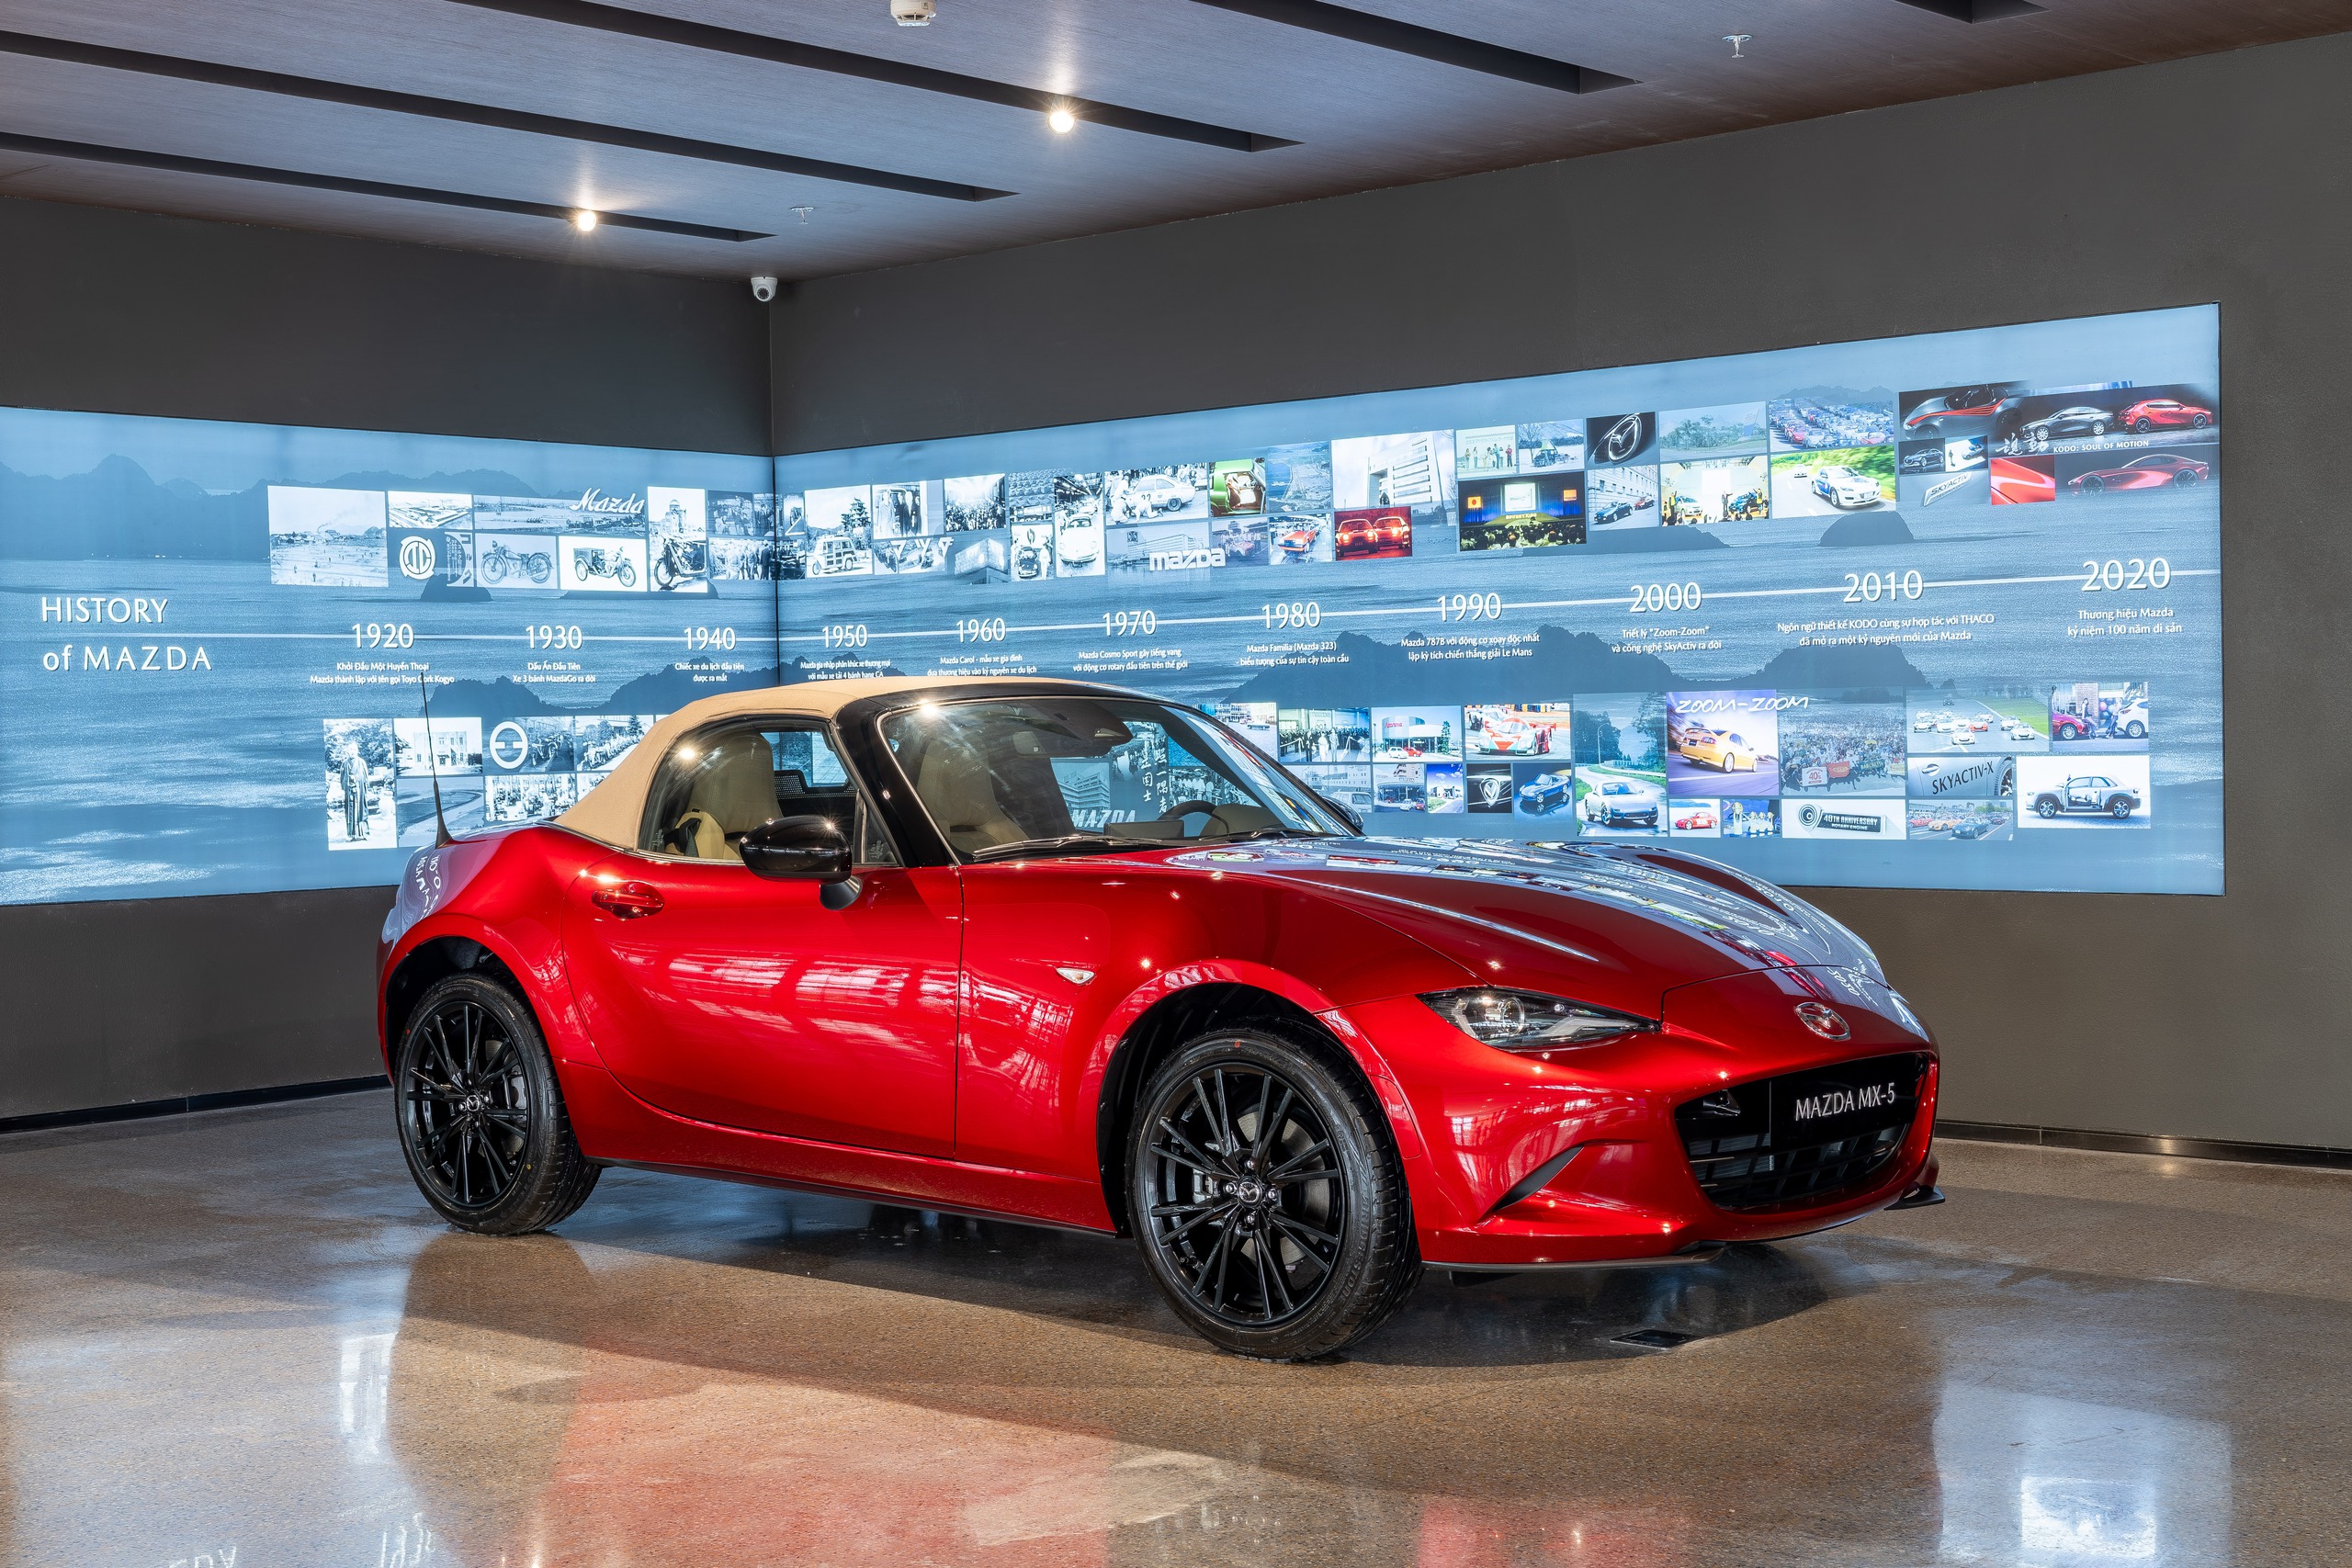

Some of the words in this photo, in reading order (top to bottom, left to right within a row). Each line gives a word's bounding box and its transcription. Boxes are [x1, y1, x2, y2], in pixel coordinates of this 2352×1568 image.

[2053, 445, 2079, 453] KODO:
[1931, 473, 1969, 496] SKYACTIV
[570, 487, 645, 514] Mazda
[890, 536, 954, 563] マツダ
[1148, 547, 1226, 571] mazda
[1843, 570, 1924, 602] 2010
[2081, 558, 2171, 592] 2020
[1437, 592, 1501, 621] 1990
[1630, 582, 1702, 613] 2000
[41, 597, 169, 624] HISTORY
[1261, 602, 1321, 628] 1980
[2078, 610, 2114, 623] Thương
[2116, 608, 2137, 620] hiệu
[2140, 606, 2174, 617] Mazda
[956, 617, 1006, 643] 1960
[1102, 610, 1156, 636] 1970
[1623, 627, 1638, 638] Triết
[1641, 628, 1647, 639] lý
[1649, 626, 1709, 637] "Zoom-Zoom"
[1777, 622, 1799, 634] Ngôn
[1801, 622, 1816, 633] ngữ
[1817, 619, 1836, 630] thiết
[1838, 619, 1849, 629] kế
[1849, 619, 1878, 629] KODO
[1880, 618, 1900, 630] cùng
[1901, 619, 1912, 628] sự
[1912, 617, 1929, 628] hợp
[1931, 616, 1944, 626] tác
[1946, 615, 1959, 625] với
[1960, 615, 1995, 624] THACO
[2067, 626, 2078, 637] kỷ
[2080, 626, 2105, 637] niệm
[2108, 626, 2127, 635] 100
[2129, 624, 2150, 634] năm
[2153, 625, 2163, 633] di
[2165, 624, 2182, 633] sản
[352, 623, 414, 649] 1920
[526, 626, 582, 649] 1930
[684, 627, 736, 650] 1940
[822, 625, 867, 649] 1950
[1247, 645, 1268, 653] Mazda
[1270, 644, 1293, 652] Familia
[1294, 643, 1319, 653] (Mazda
[1320, 642, 1337, 652] 323)
[1611, 644, 1621, 653] và
[1622, 643, 1641, 655] công
[1643, 642, 1662, 654] nghệ
[1664, 641, 1696, 653] SkyActiv
[1709, 639, 1722, 649] đời
[1800, 637, 1810, 646] đã
[1812, 636, 1826, 645] mở
[1838, 635, 1856, 646] một
[1858, 635, 1868, 646] kỷ
[1870, 633, 1901, 645] nguyên
[1904, 633, 1920, 642] mới
[1922, 632, 1938, 641] của
[1940, 631, 1972, 640] Mazda
[42, 645, 74, 671] of
[83, 646, 212, 671] MAZDA
[1675, 696, 1808, 713] ZOOM-ZOOM
[1932, 761, 1994, 795] SKYACTIV-X
[1073, 810, 1136, 828] MAZDA
[1824, 814, 1839, 823] 40TH
[1841, 816, 1878, 826] ANNIVERSARY
[1795, 1089, 1855, 1121] MAZDA
[1859, 1082, 1894, 1110] MX-5
